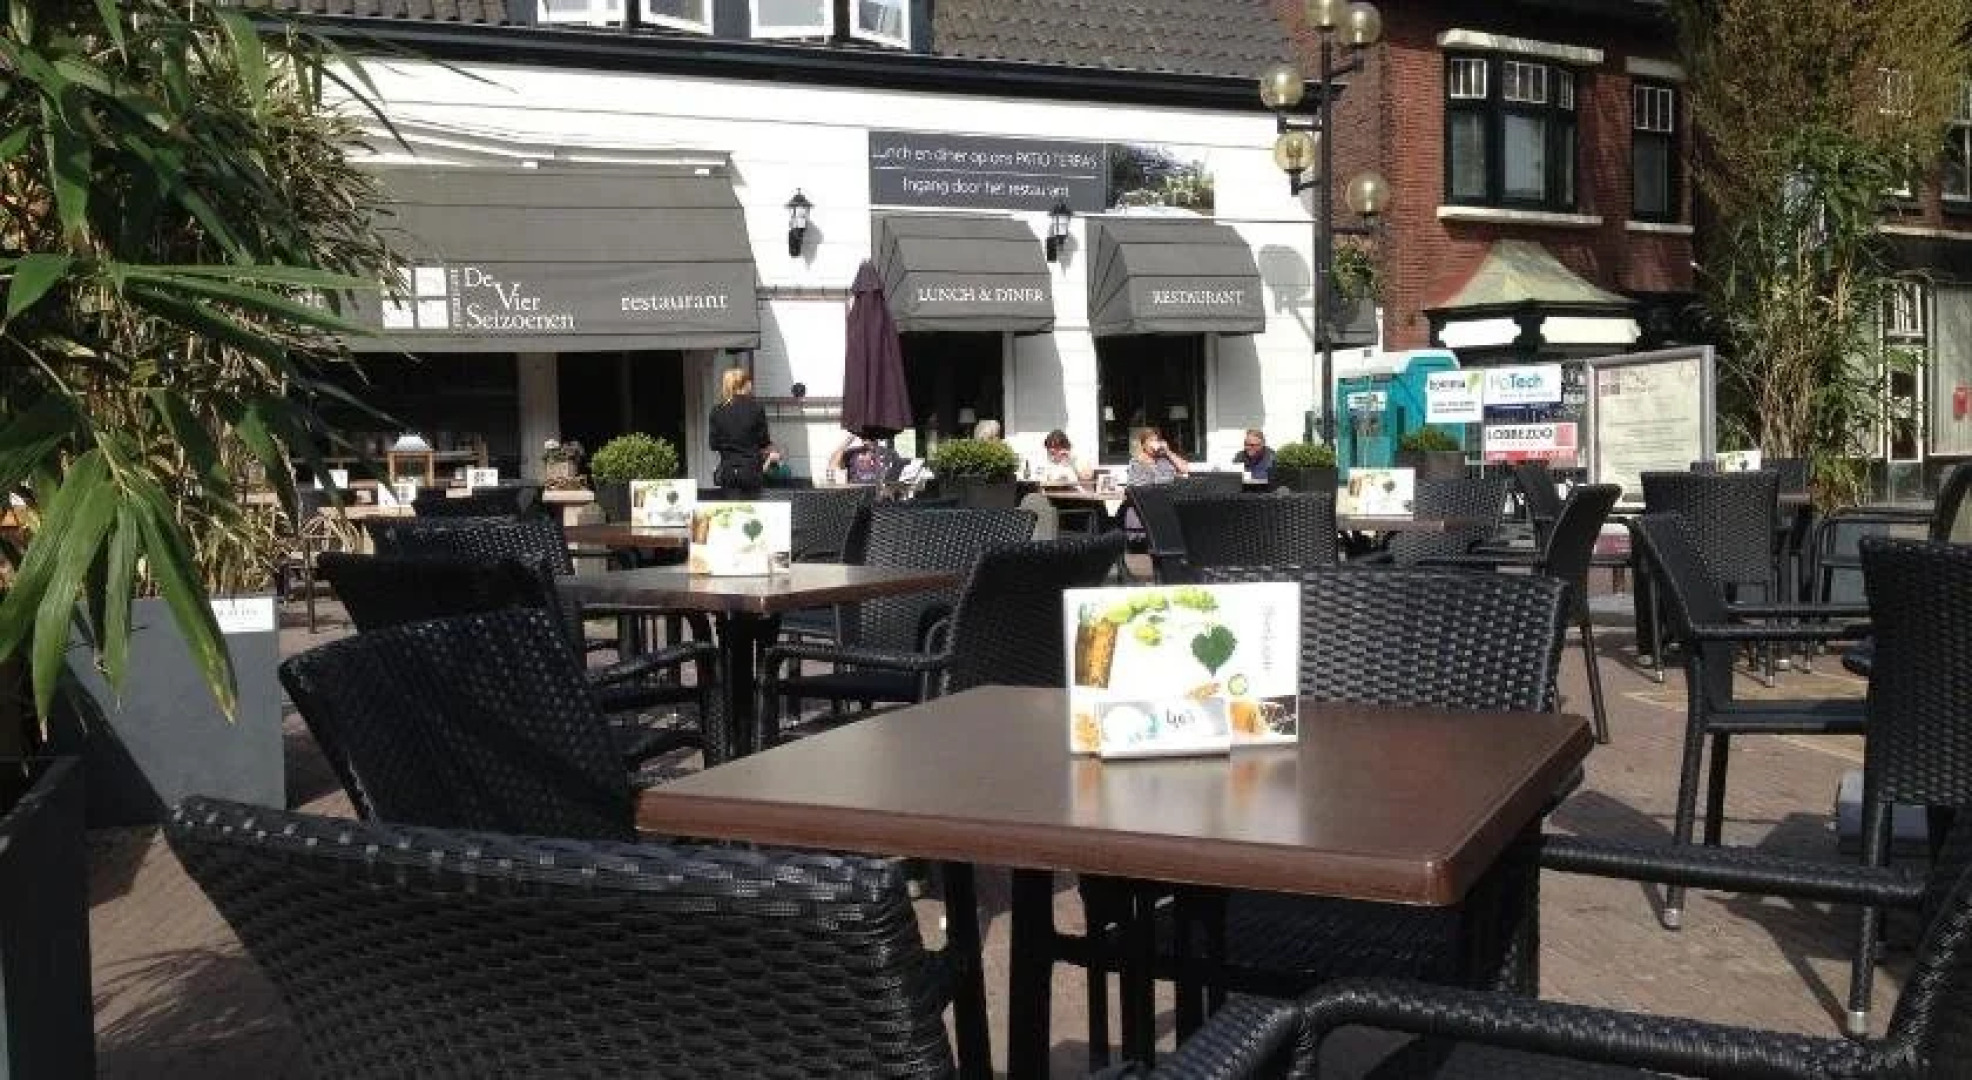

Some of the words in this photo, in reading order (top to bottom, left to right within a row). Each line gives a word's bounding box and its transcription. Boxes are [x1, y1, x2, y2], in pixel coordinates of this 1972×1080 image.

[915, 150, 932, 161] en
[971, 153, 987, 167] op
[1016, 152, 1050, 167] PATIO
[903, 177, 949, 196] Ingang
[952, 179, 980, 194] door
[985, 180, 1005, 195] het
[1008, 183, 1070, 198] restaurant
[464, 267, 493, 287] De
[491, 281, 541, 311] Vier
[620, 291, 728, 312] restaurant
[917, 287, 975, 302] LUNCH
[978, 287, 992, 302] &
[995, 288, 1043, 302] DINER
[1152, 289, 1245, 304] RESTAURANT
[466, 303, 576, 330] Seizoenen
